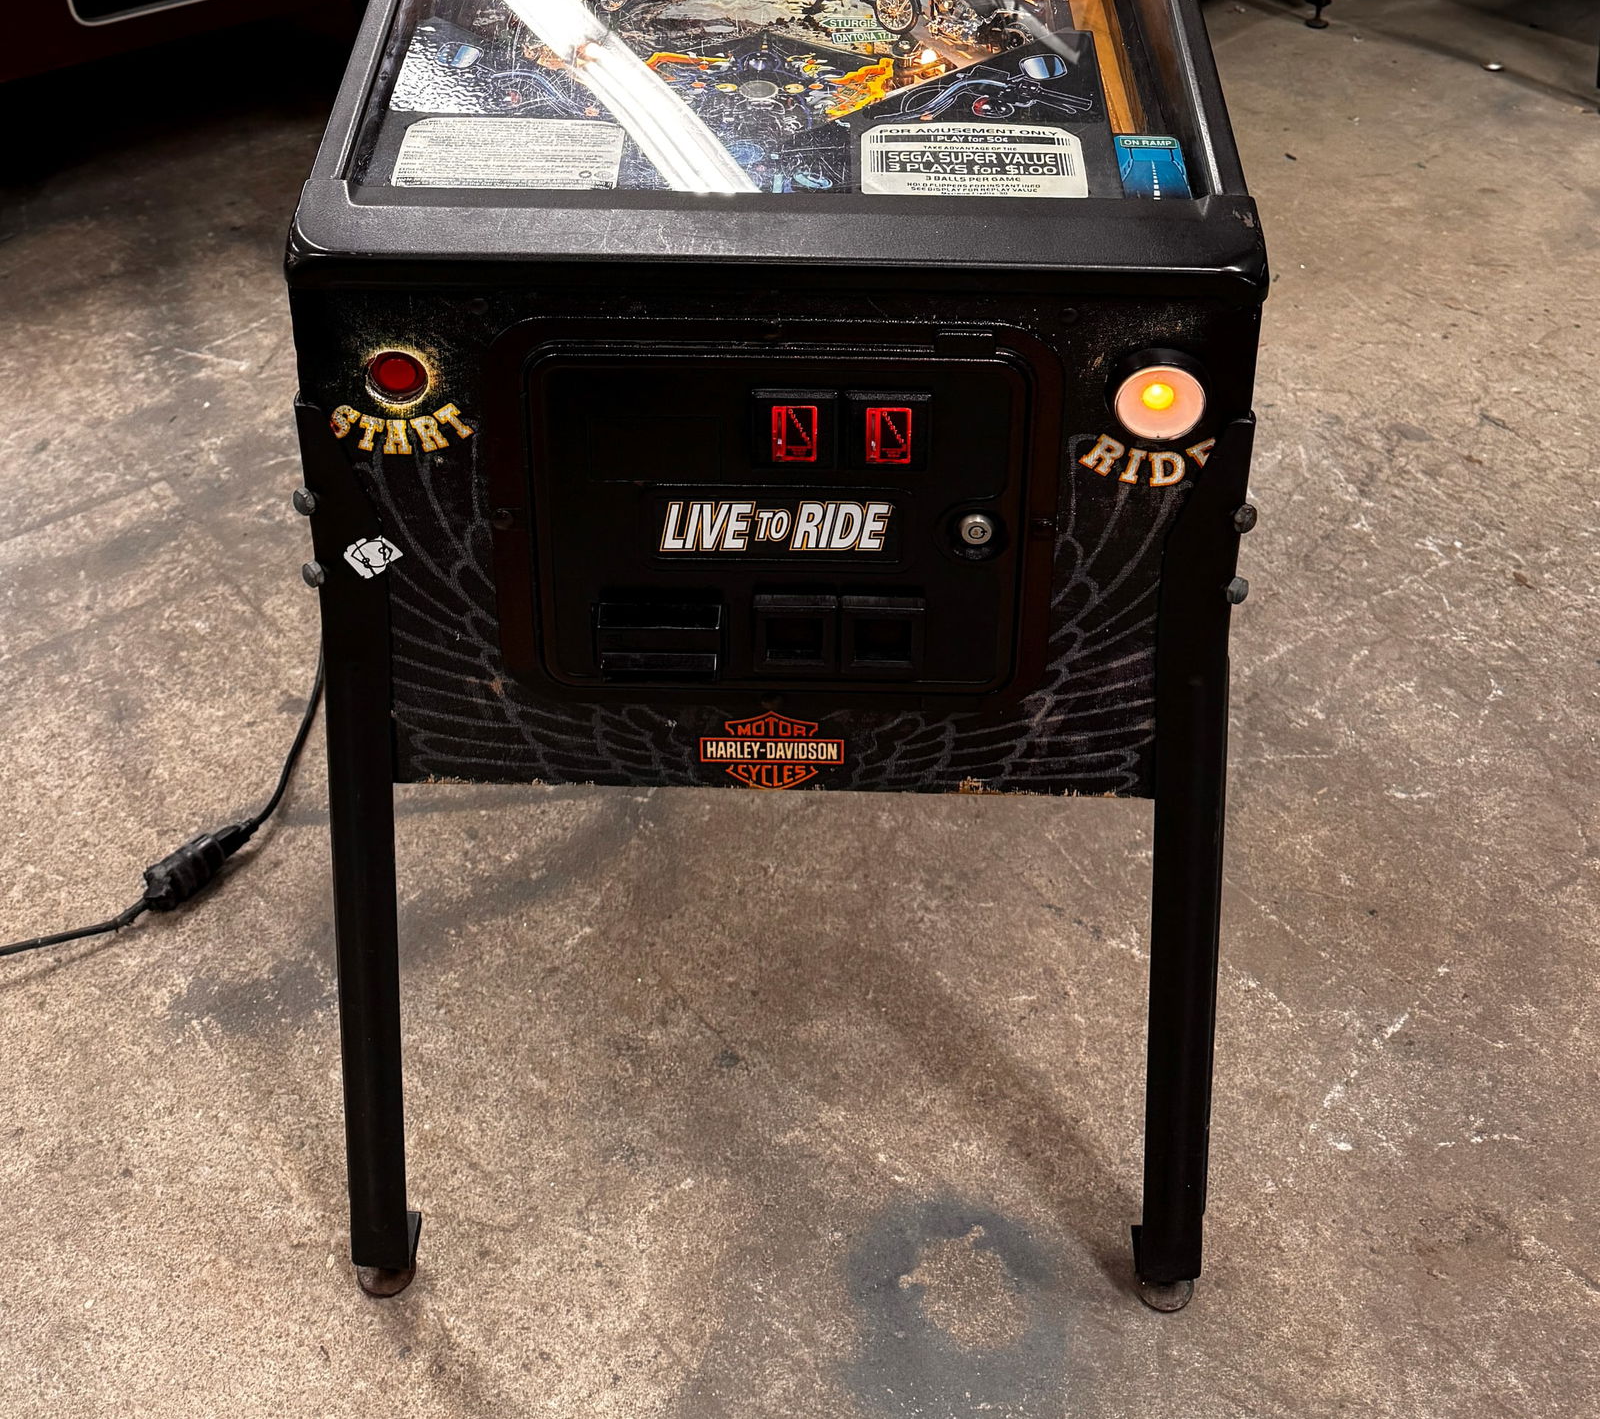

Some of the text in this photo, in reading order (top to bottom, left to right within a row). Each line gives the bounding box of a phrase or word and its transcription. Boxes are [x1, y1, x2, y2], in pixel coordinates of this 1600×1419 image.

[829, 19, 878, 28] STURGIS
[836, 32, 877, 42] DAYTONA
[915, 127, 1015, 135] AMUSEMENT
[887, 151, 1056, 165] SEGA SUPER VALUE
[888, 162, 1057, 175] 3 PLAYS for $1.00
[330, 402, 475, 455] START
[660, 500, 898, 552] LIVE TO RIDE
[737, 716, 807, 737] MOTOR
[705, 740, 838, 761] HARLEY-DAVIDSON
[737, 764, 807, 788] CYCLES
